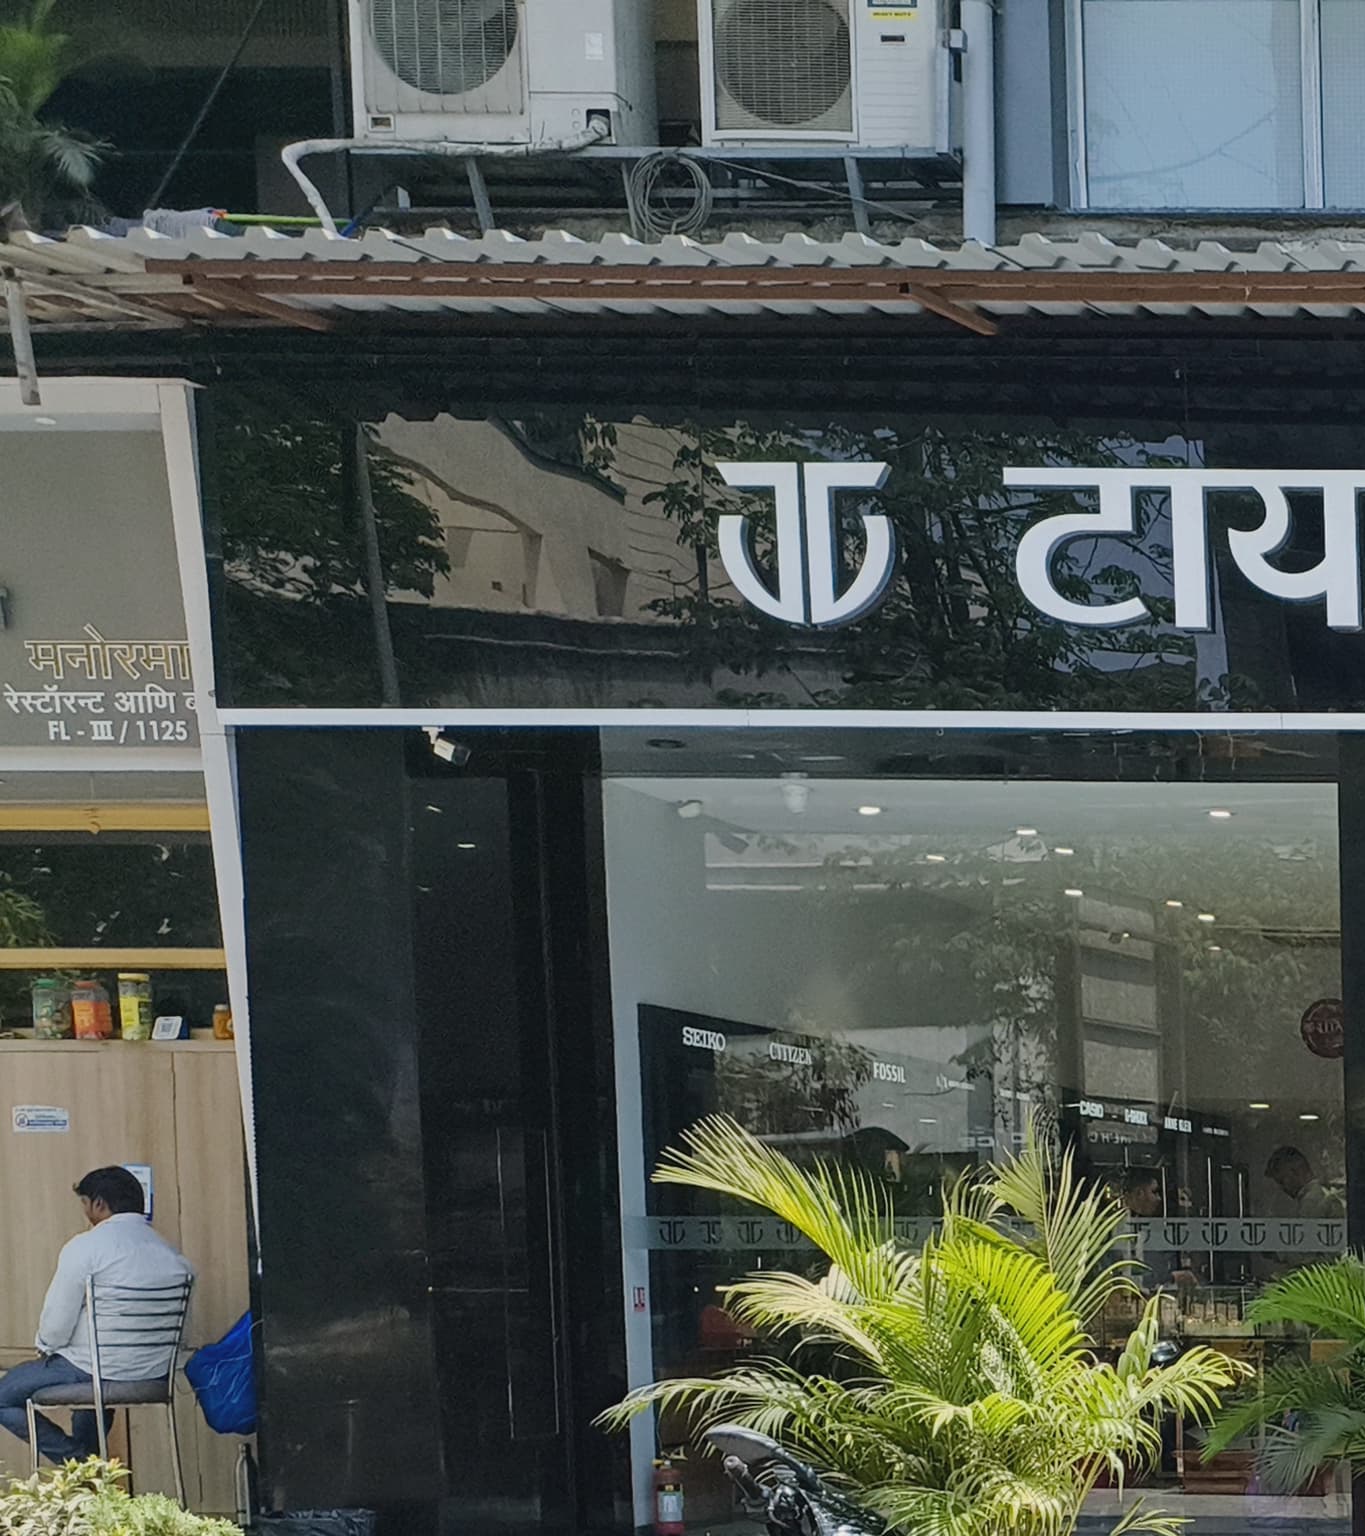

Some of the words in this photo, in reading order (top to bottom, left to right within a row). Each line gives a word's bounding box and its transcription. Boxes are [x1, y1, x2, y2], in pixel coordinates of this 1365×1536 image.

[115, 683, 176, 714] आणि
[49, 720, 71, 741] FL
[137, 720, 188, 741] 1125
[682, 1026, 726, 1051] SEIKO
[769, 1042, 812, 1066] CITIZEN
[872, 1062, 906, 1084] FOSSIL
